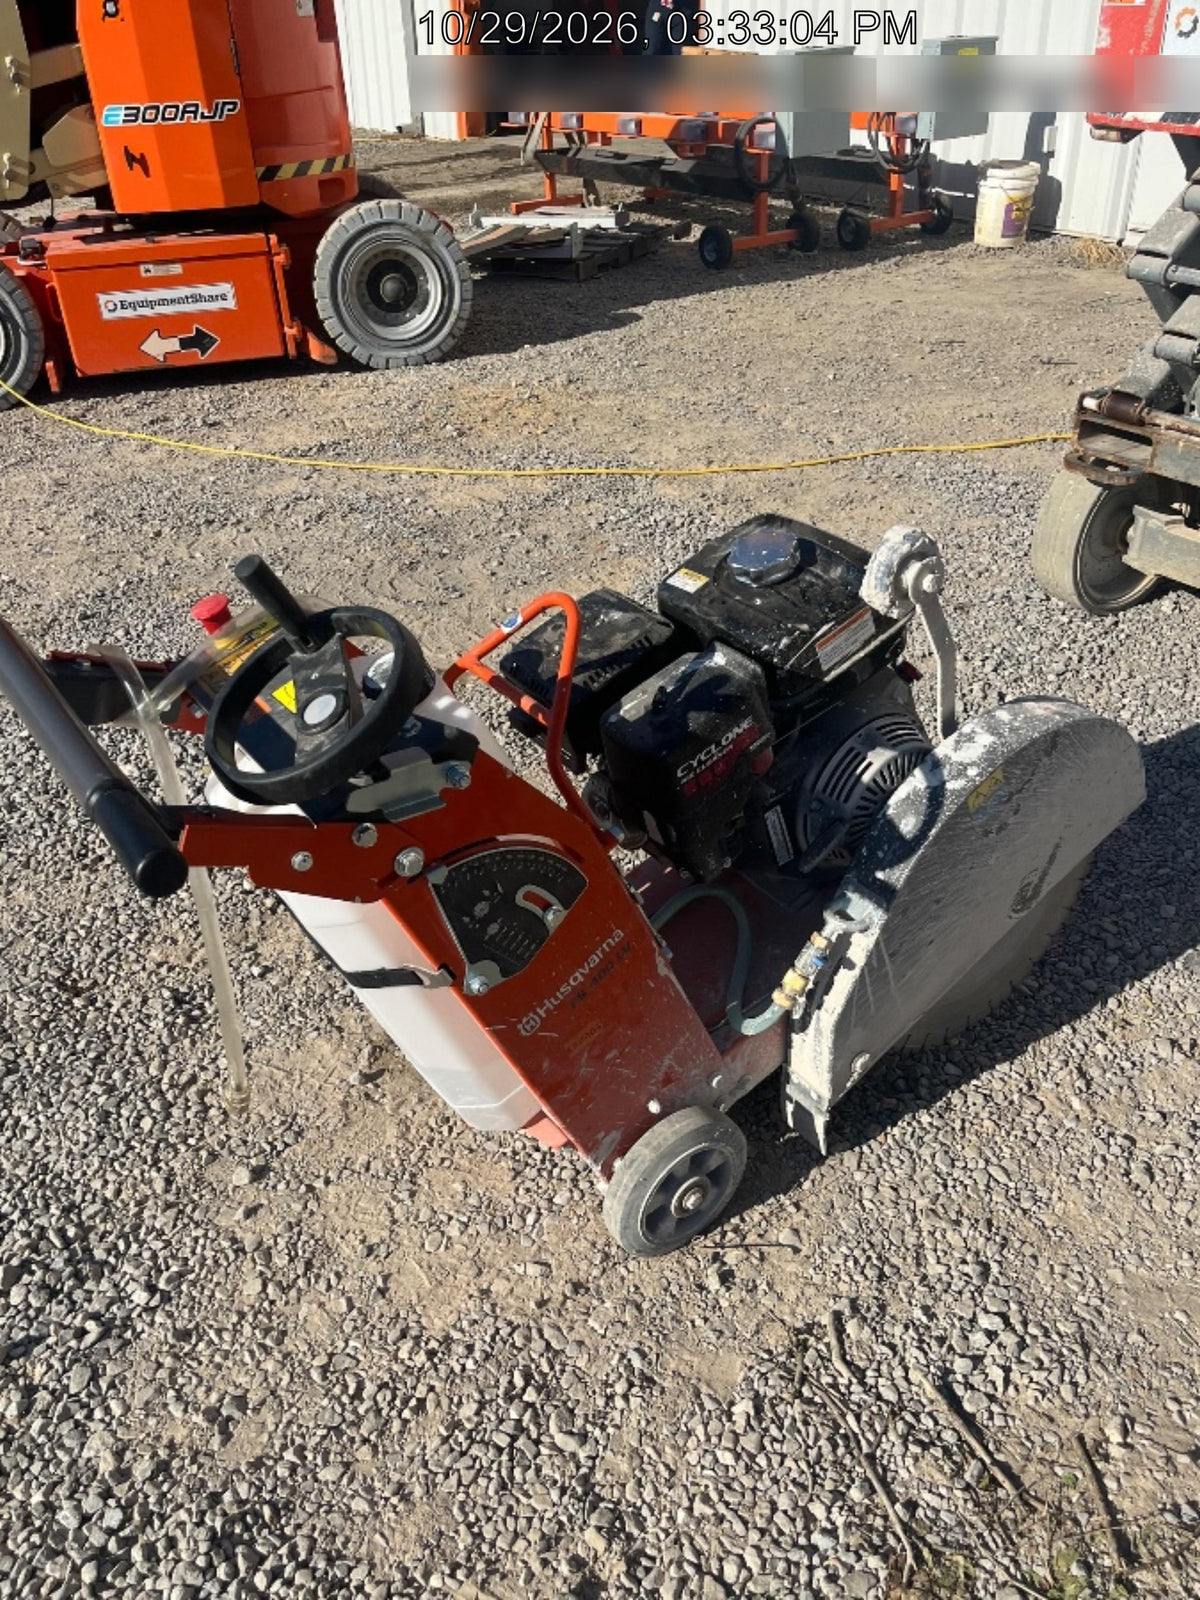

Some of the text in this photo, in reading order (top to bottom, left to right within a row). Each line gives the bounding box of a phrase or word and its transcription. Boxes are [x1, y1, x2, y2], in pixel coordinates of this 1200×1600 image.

[103, 100, 239, 125] E300AJP
[119, 292, 228, 311] EquipmentShare
[677, 715, 753, 777] CYCLONE
[537, 929, 624, 1018] Husqvarna
